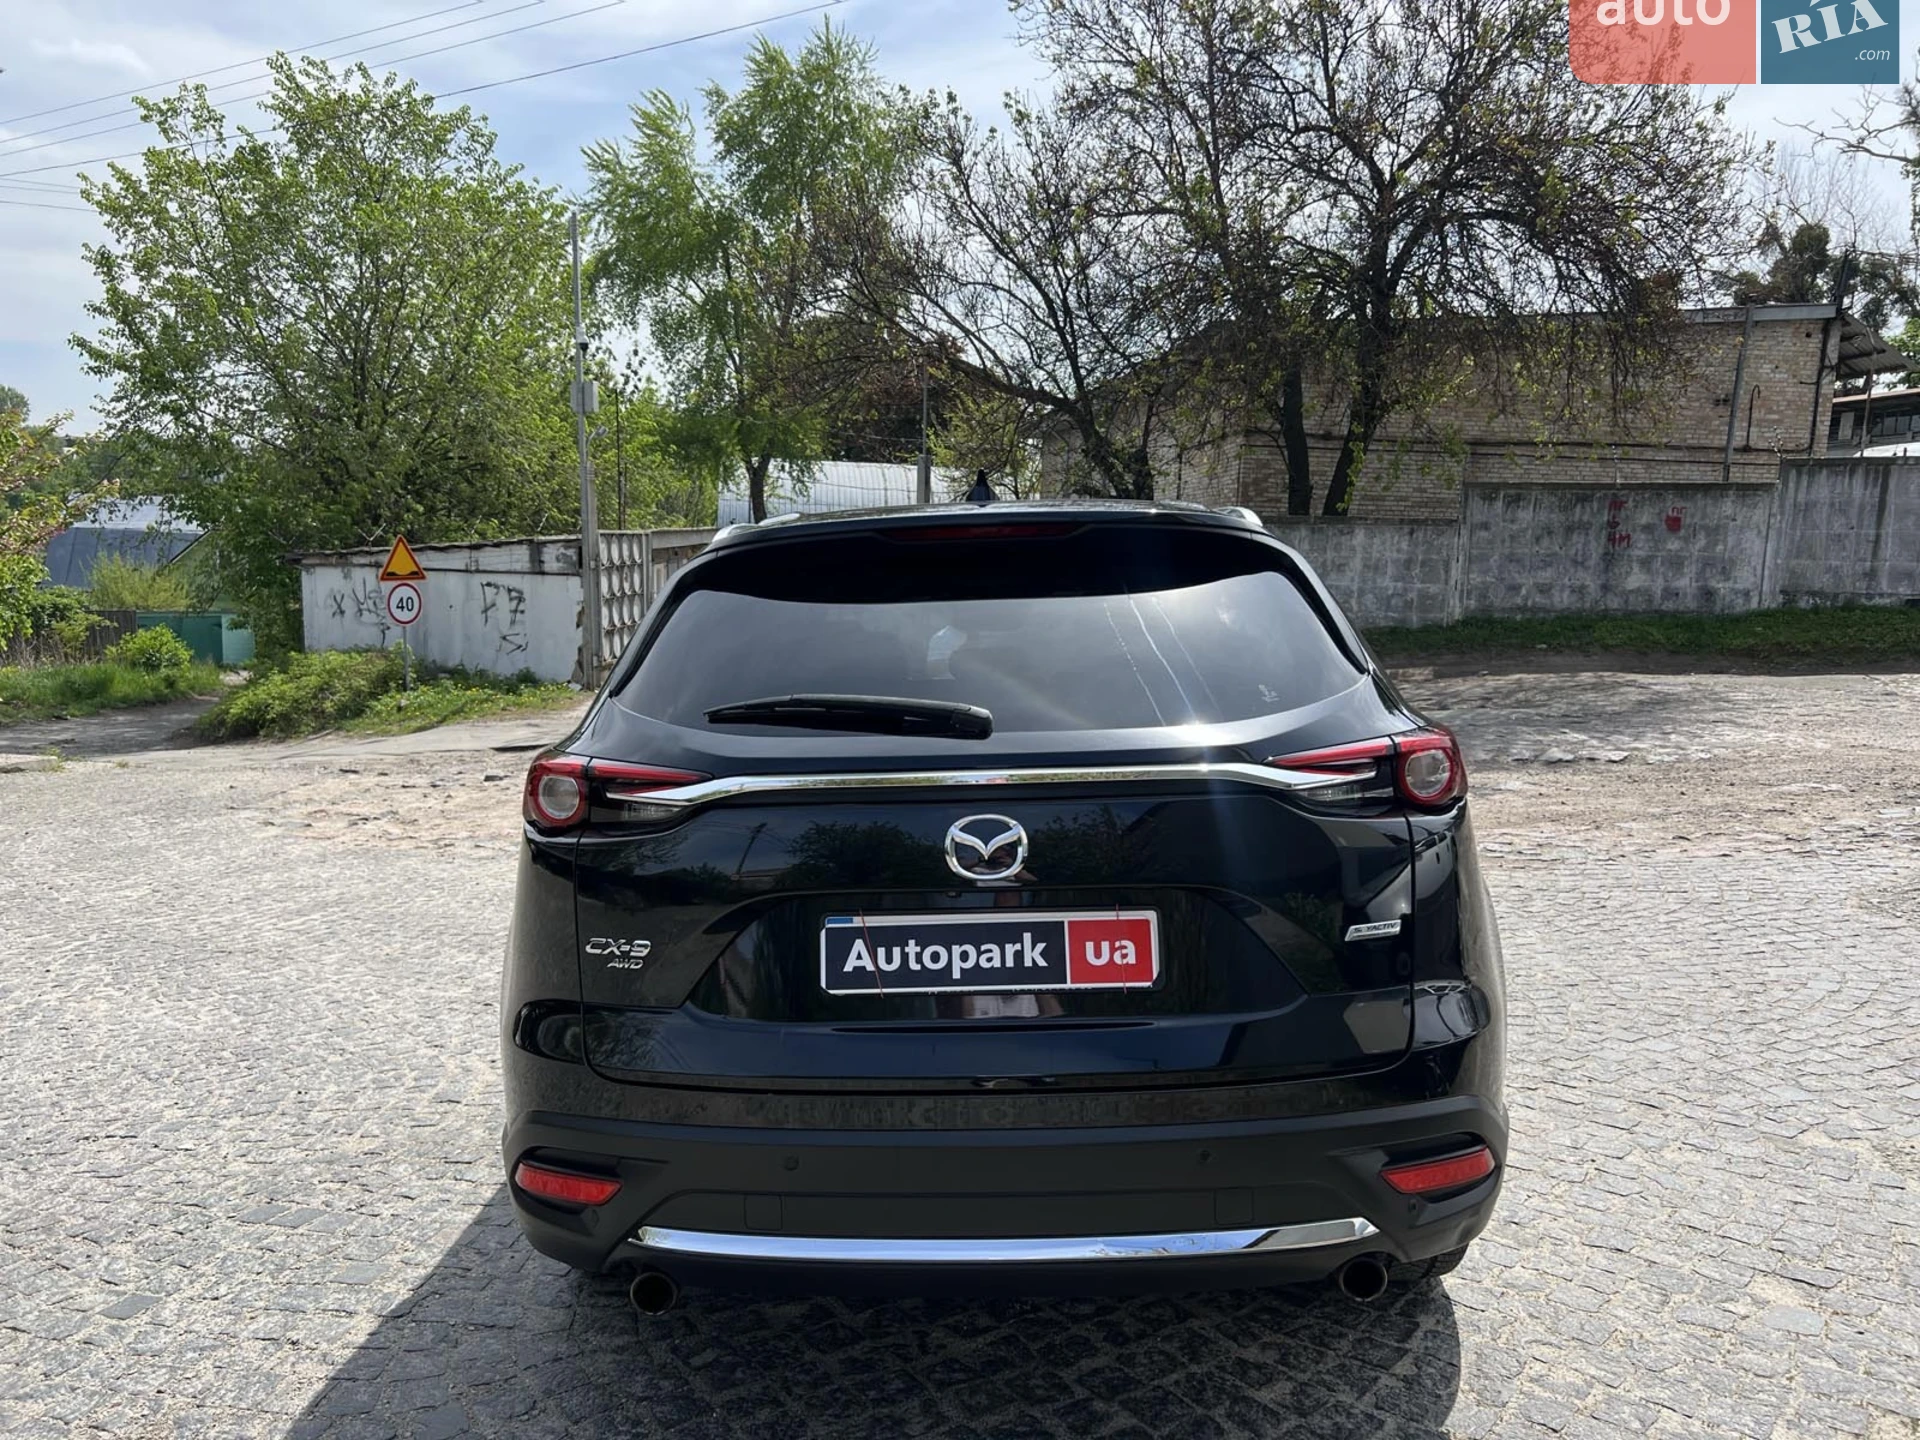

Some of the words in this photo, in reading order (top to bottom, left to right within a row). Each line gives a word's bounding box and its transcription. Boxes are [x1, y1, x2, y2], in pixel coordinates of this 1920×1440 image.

[396, 596, 415, 612] 40
[1353, 922, 1398, 933] SYACTIV
[585, 937, 652, 958] CX-9
[843, 932, 1048, 979] Autopark
[1085, 939, 1136, 966] ua
[606, 957, 644, 970] AWD
